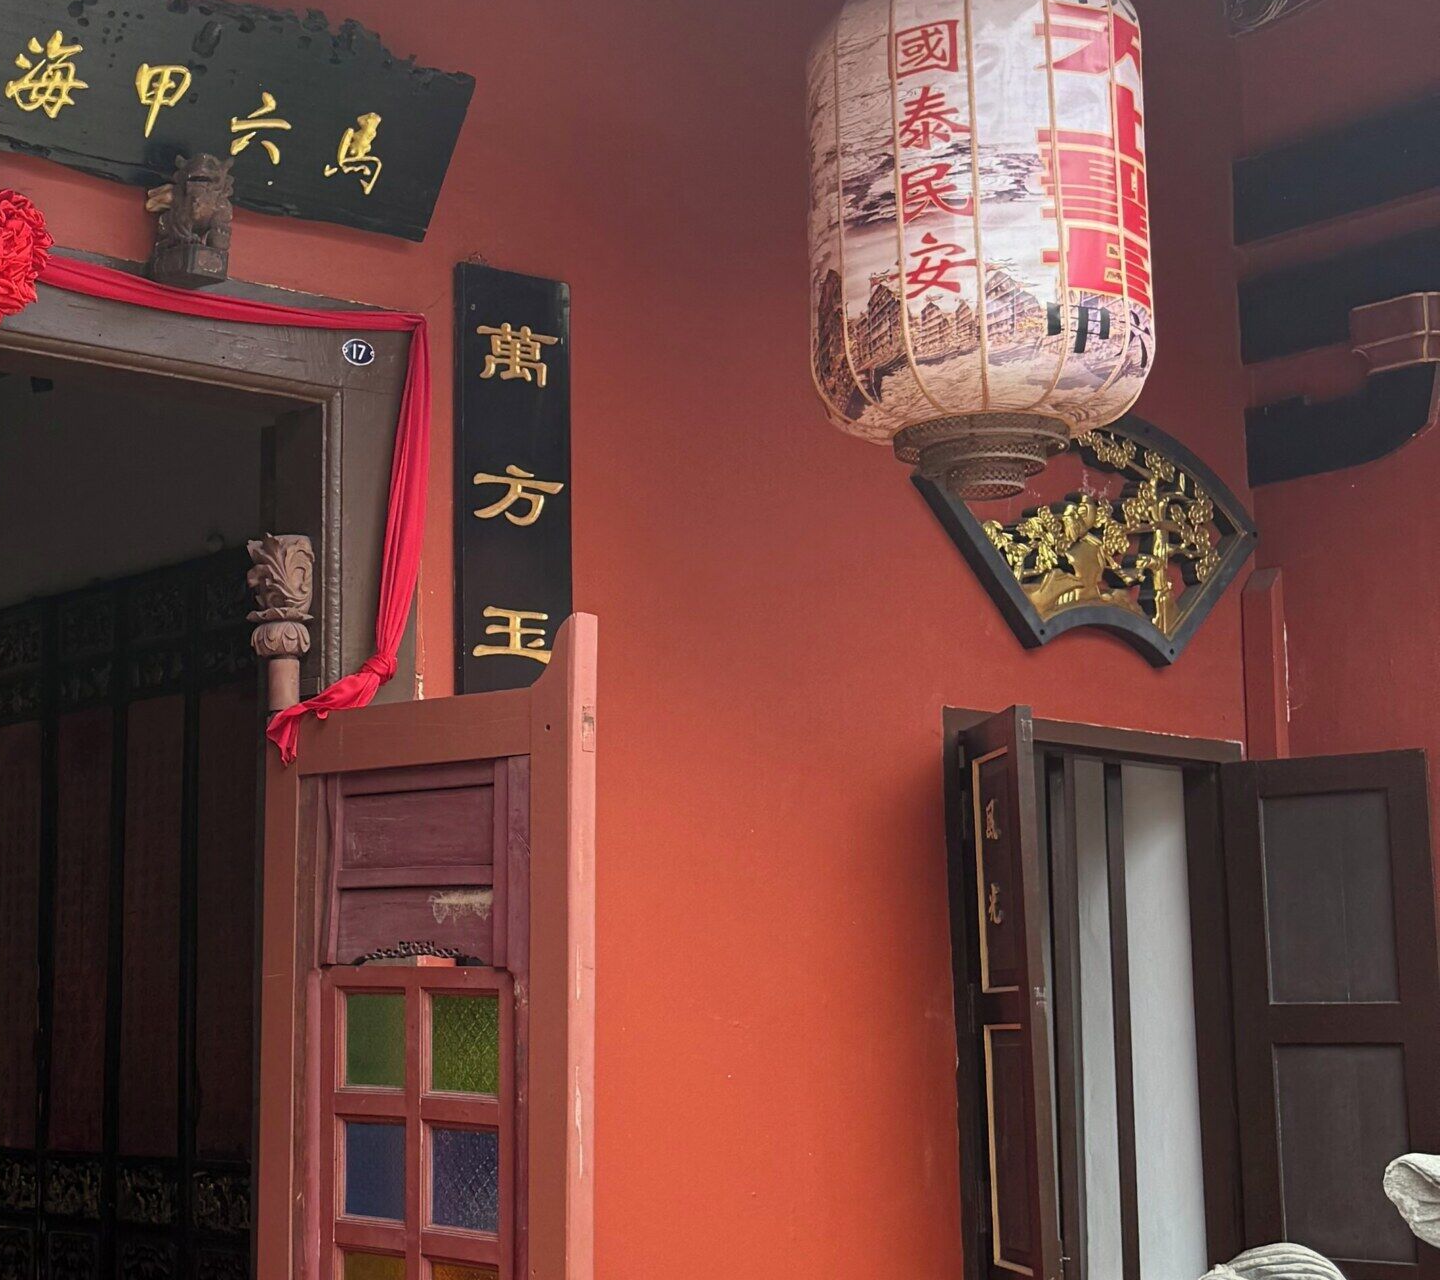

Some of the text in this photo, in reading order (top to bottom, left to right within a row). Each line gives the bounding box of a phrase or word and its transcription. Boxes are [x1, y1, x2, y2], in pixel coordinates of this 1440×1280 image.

[888, 19, 978, 300] 國泰民安
[352, 343, 367, 361] 17
